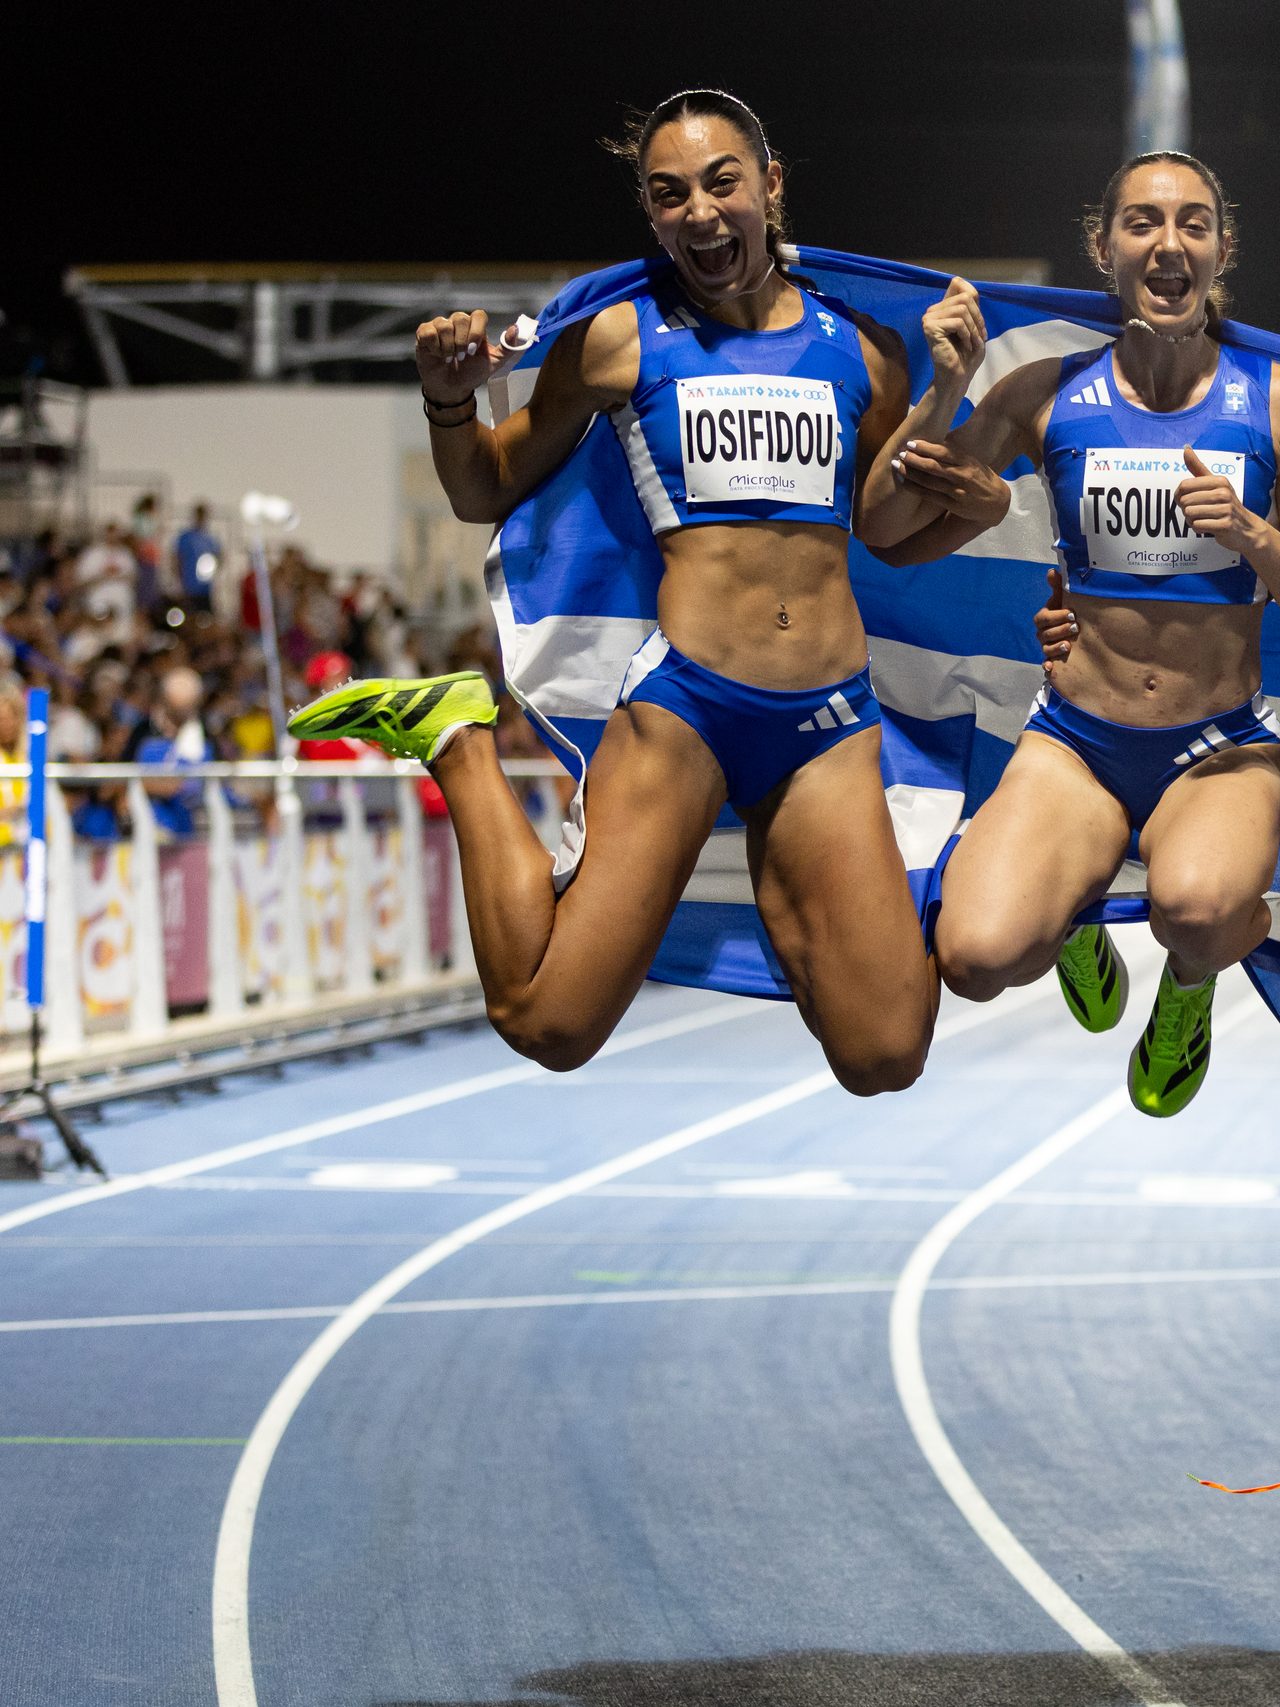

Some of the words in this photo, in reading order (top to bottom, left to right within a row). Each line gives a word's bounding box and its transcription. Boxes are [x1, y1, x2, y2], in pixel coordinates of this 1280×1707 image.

[707, 386, 765, 397] TARANTO
[767, 387, 800, 399] 2026
[685, 409, 833, 467] IOSIFIDOU
[1113, 460, 1171, 472] TARANTO
[1087, 487, 1215, 538] TSOUK
